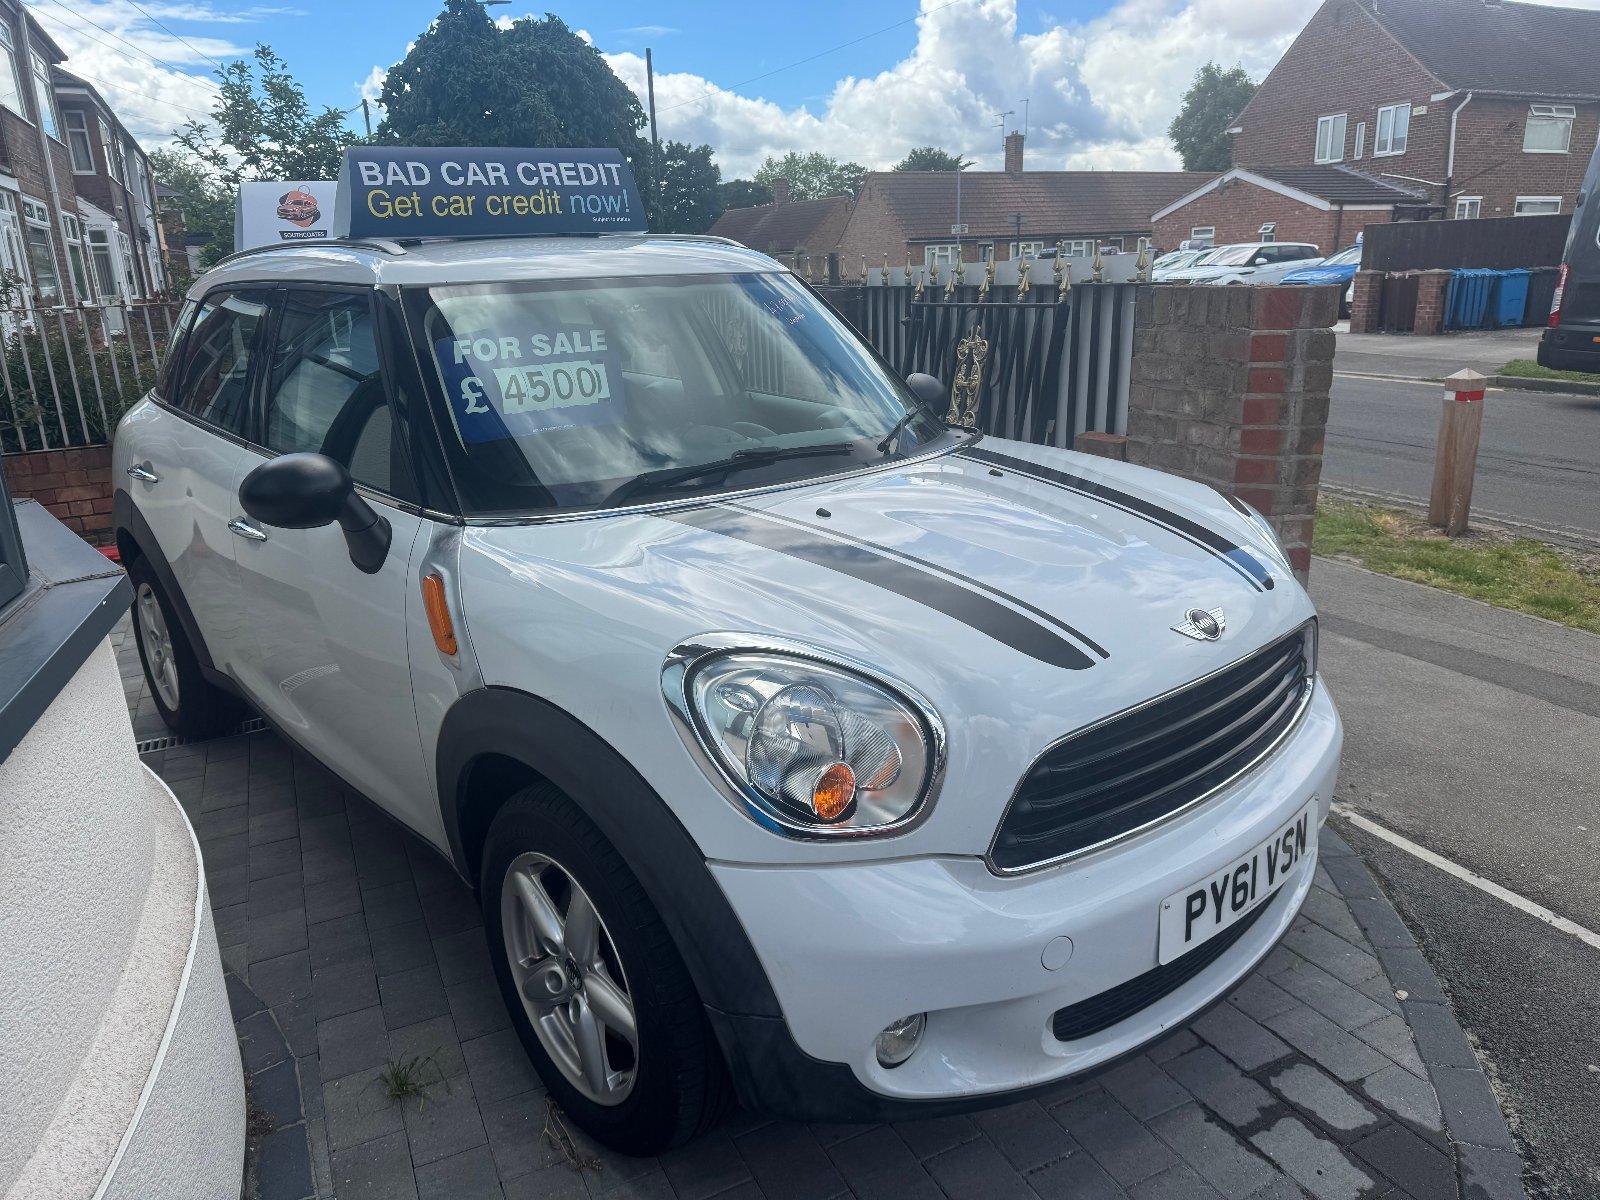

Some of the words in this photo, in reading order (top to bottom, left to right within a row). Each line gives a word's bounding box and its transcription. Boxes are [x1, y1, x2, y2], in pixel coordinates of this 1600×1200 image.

[357, 161, 431, 186] BAD
[440, 161, 510, 186] CAR
[516, 161, 621, 186] CREDIT
[367, 189, 424, 218] Get
[431, 195, 476, 217] car
[485, 188, 563, 216] credit
[569, 188, 630, 214] now!
[283, 231, 325, 239] SOUTHCOATES
[453, 336, 523, 364] FOR
[531, 329, 608, 357] SALE
[460, 376, 490, 415] £
[1184, 854, 1258, 943] PY61
[1266, 812, 1308, 887] VSN
